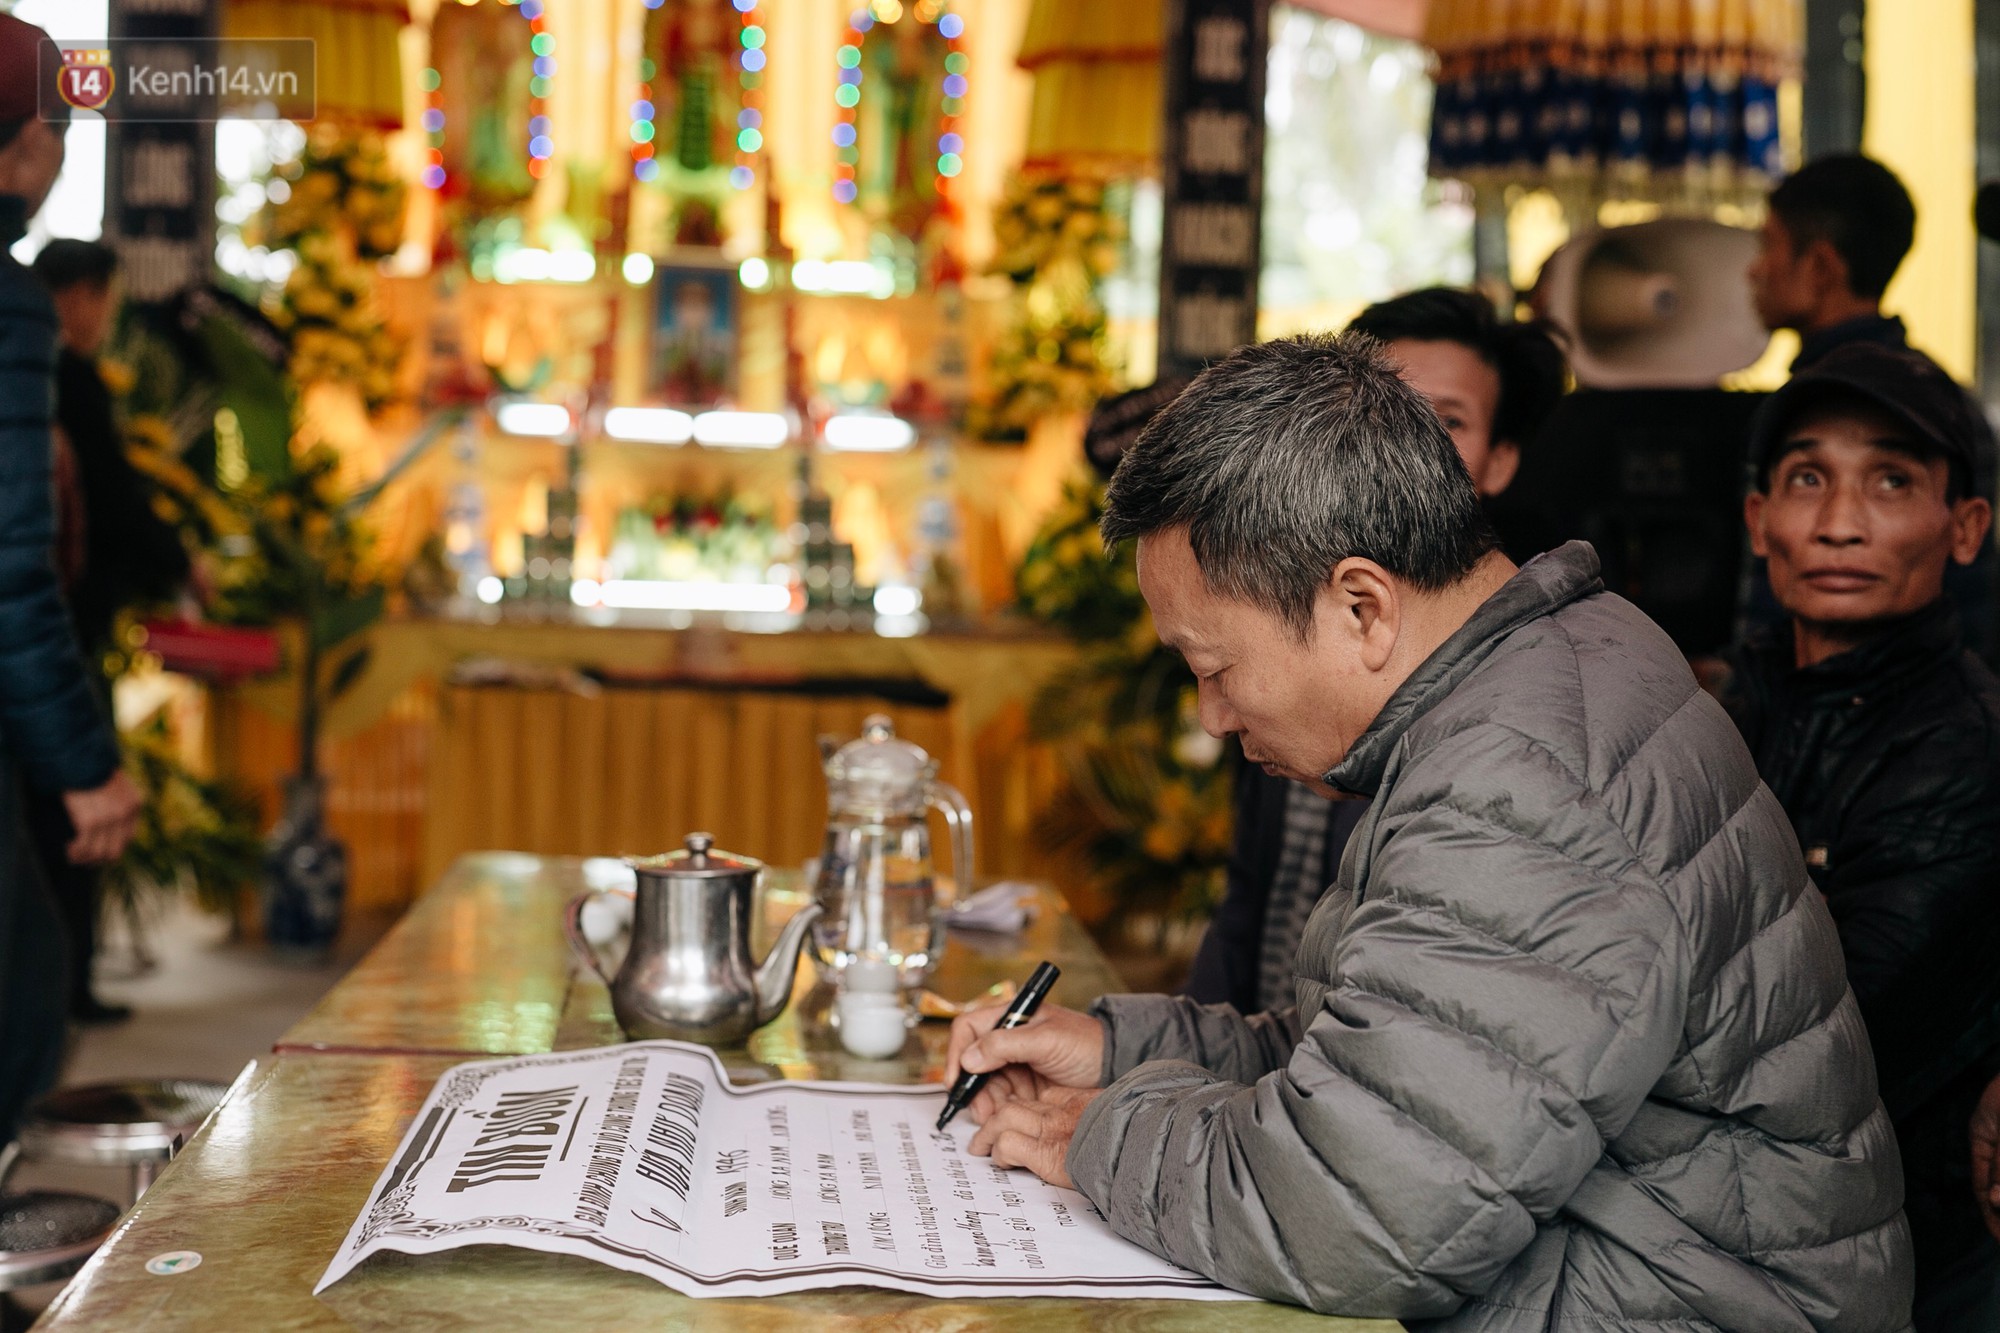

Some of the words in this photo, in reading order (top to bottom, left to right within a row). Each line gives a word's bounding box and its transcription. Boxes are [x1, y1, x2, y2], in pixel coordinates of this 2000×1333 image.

[464, 1086, 579, 1146] BUỒN
[593, 1132, 628, 1143] VÔ
[647, 1113, 696, 1165] NHƯ
[589, 1142, 625, 1156] TÔI
[769, 1146, 792, 1165] NAM
[446, 1144, 553, 1192] TIN
[581, 1155, 621, 1187] CHÚNG
[716, 1149, 749, 1174] 1946
[817, 1153, 837, 1170] NAM
[573, 1182, 613, 1209] ĐÌNH
[955, 1191, 974, 1200] đã
[995, 1190, 1025, 1207] ngày
[574, 1206, 607, 1227] GIA
[724, 1197, 747, 1217] SINH
[914, 1206, 938, 1230] chúng
[1002, 1218, 1035, 1231] giờ
[767, 1223, 800, 1243] QUÁN
[920, 1232, 942, 1253] đình
[1007, 1239, 1039, 1252] hồi
[925, 1255, 947, 1269] Gia
[1018, 1254, 1045, 1269] vào
